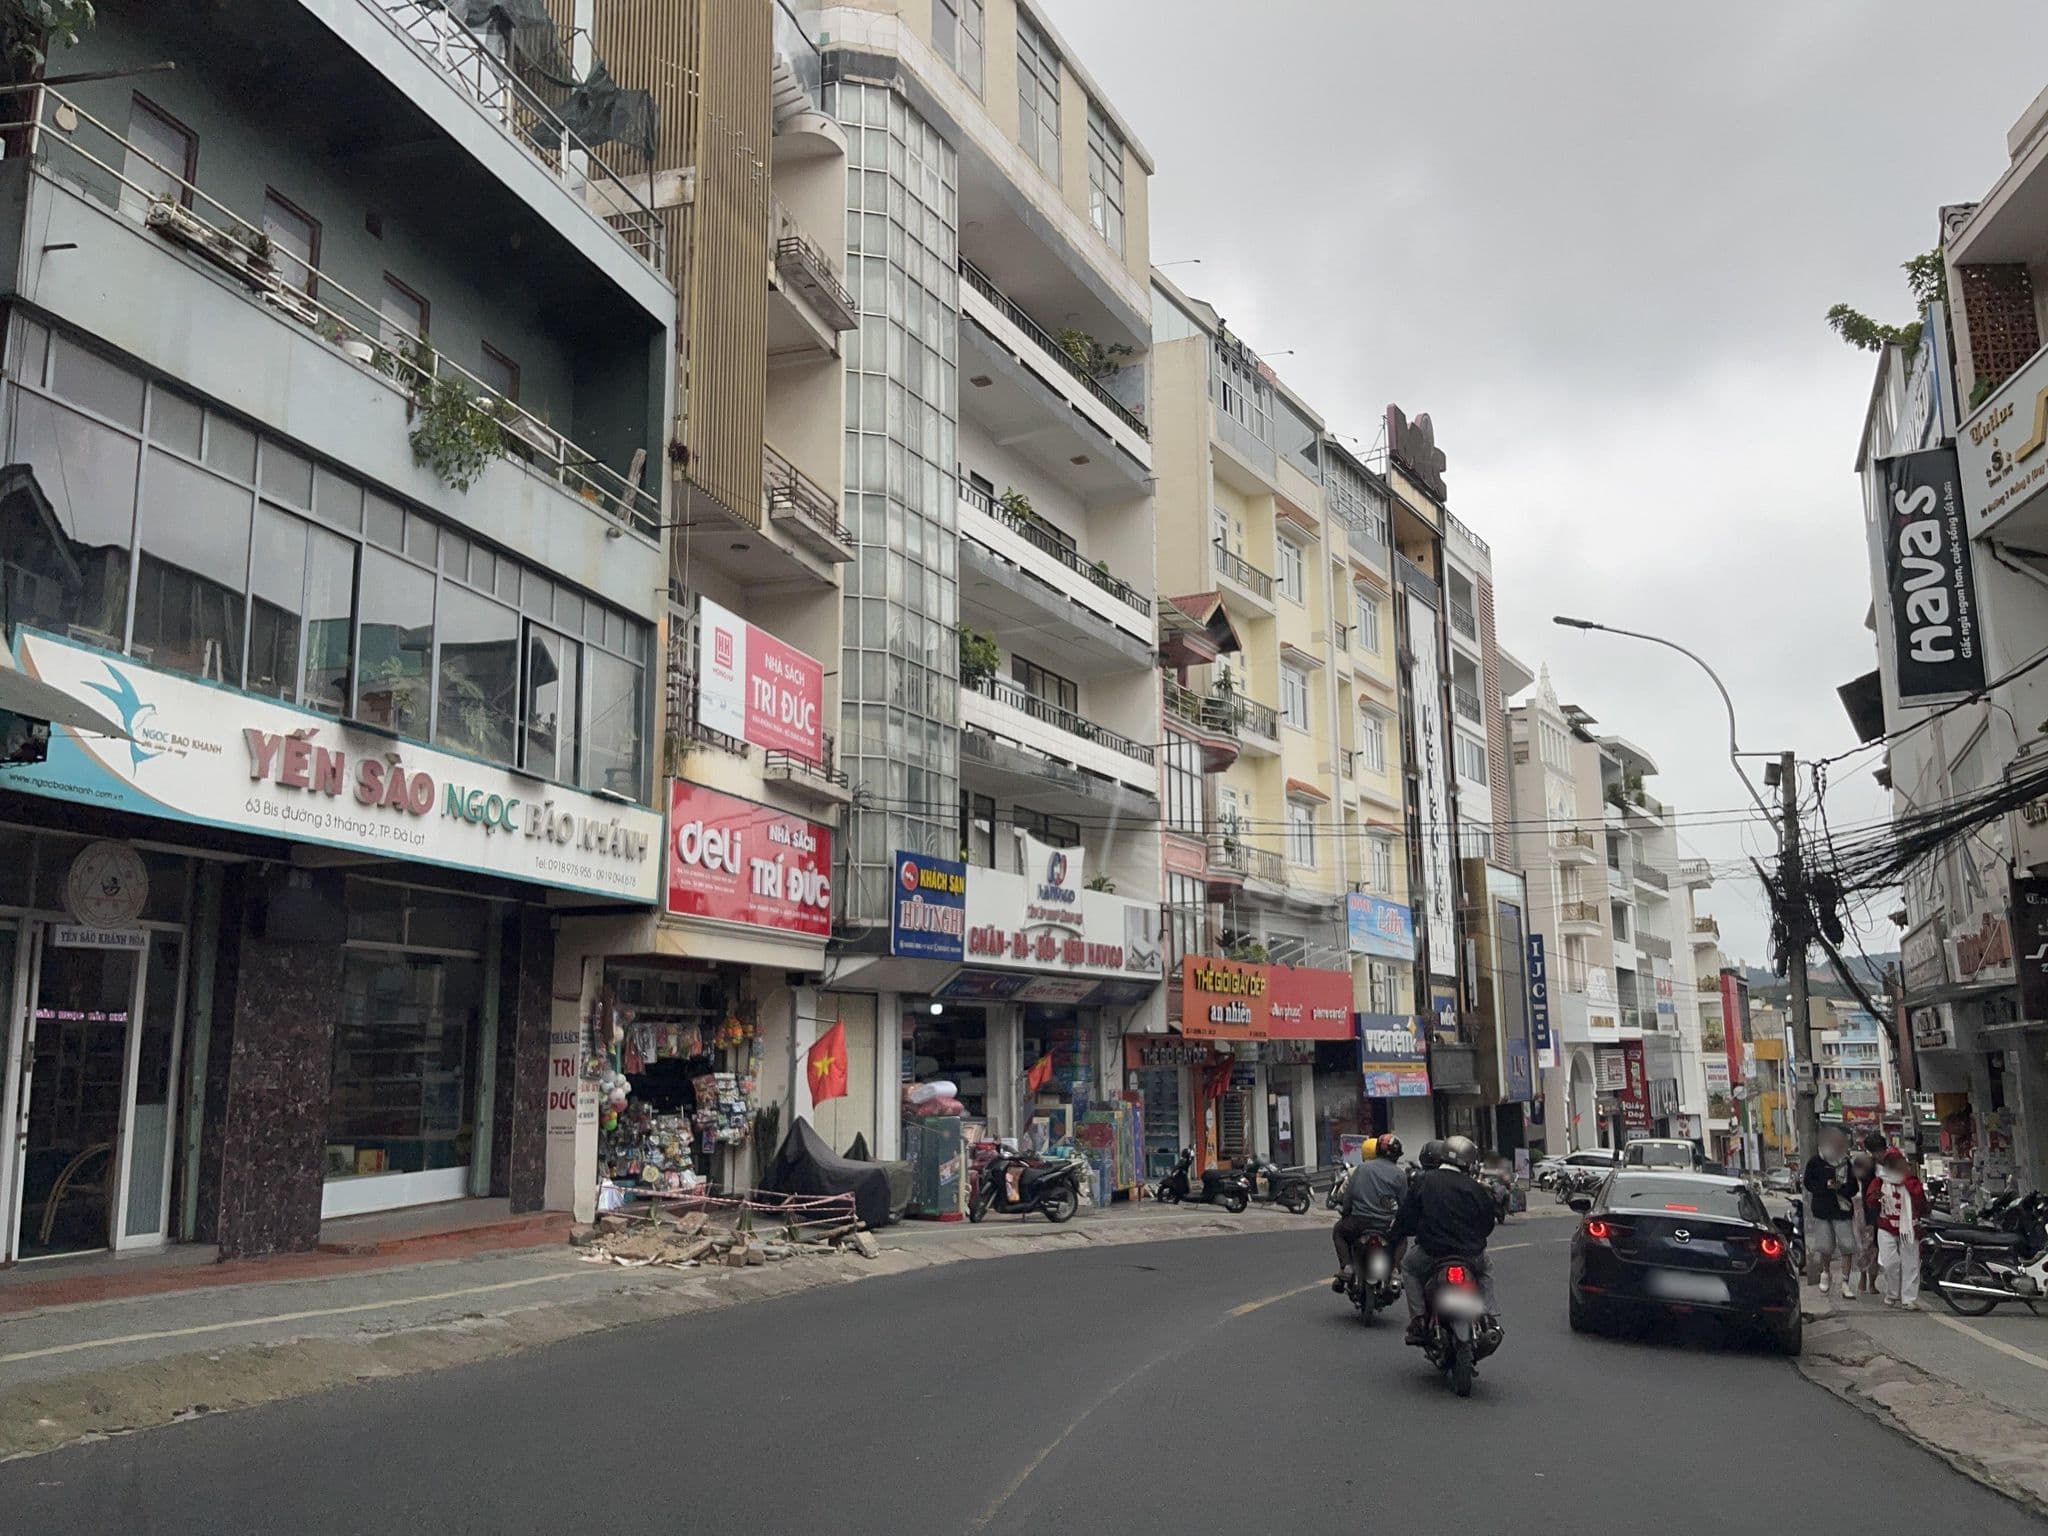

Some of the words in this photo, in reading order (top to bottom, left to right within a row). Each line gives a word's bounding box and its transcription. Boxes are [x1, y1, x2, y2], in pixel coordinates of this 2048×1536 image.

[1943, 481, 1953, 500] hơn
[1944, 502, 1955, 516] tốt
[1945, 517, 1958, 540] sống
[1950, 542, 1962, 564] cuộc
[1954, 565, 1963, 587] hơn,
[1957, 589, 1969, 614] ngon
[1959, 616, 1971, 635] ngủ
[1959, 637, 1972, 659] Giấc
[765, 653, 783, 677] NHÀ
[785, 664, 805, 687] SÁCH
[752, 675, 777, 717] TRÍ
[780, 691, 815, 735] ĐỨC
[243, 728, 345, 797] YẾN
[353, 752, 435, 816] SÀO
[441, 783, 520, 836] NGỌC
[245, 801, 260, 815] 63
[263, 801, 278, 817] Bis
[325, 814, 332, 827] 3
[334, 815, 367, 837] tháng
[678, 820, 741, 874] deli
[768, 824, 790, 846] NHÀ
[792, 829, 816, 853] SÁCH
[750, 853, 784, 899] TRÍ
[787, 860, 831, 909] ĐỨC
[919, 867, 948, 892] KHÁCH
[949, 875, 965, 897] SẠN
[60, 929, 77, 943] YẾN
[98, 931, 127, 945] KHÁNH
[1209, 1003, 1223, 1023] an
[553, 1054, 575, 1078] TRÍ
[550, 1086, 576, 1110] ĐỨC
